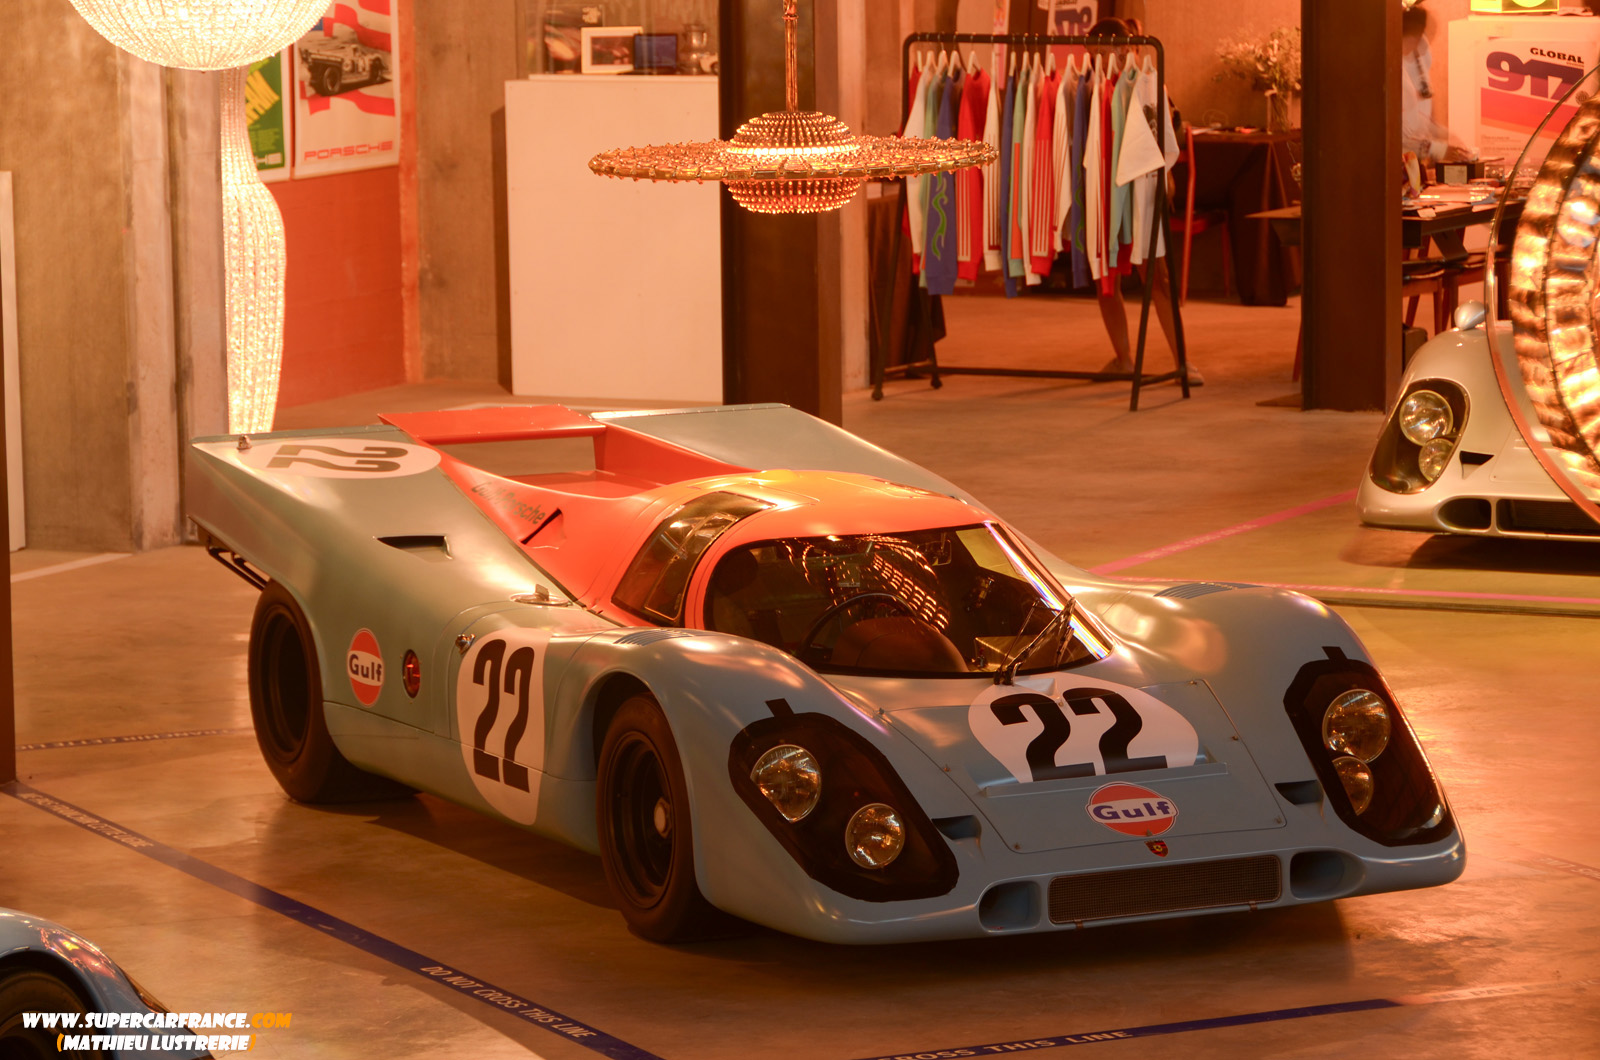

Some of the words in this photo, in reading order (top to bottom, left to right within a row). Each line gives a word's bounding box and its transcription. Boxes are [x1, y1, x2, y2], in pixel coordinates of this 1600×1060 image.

[1530, 47, 1585, 64] GLOBAL
[1486, 51, 1585, 103] 917
[304, 140, 393, 161] PORSCHE
[349, 654, 383, 682] Gulf
[472, 638, 535, 793] 22
[990, 687, 1168, 782] 22
[1092, 800, 1172, 821] Gulf
[420, 966, 453, 976] DO
[442, 976, 484, 989] NOT
[473, 989, 528, 1008] CROSS
[519, 1007, 562, 1023] THIS
[551, 1023, 597, 1038] LINE
[983, 1039, 1056, 1053] THIS
[1065, 1031, 1133, 1044] LINE
